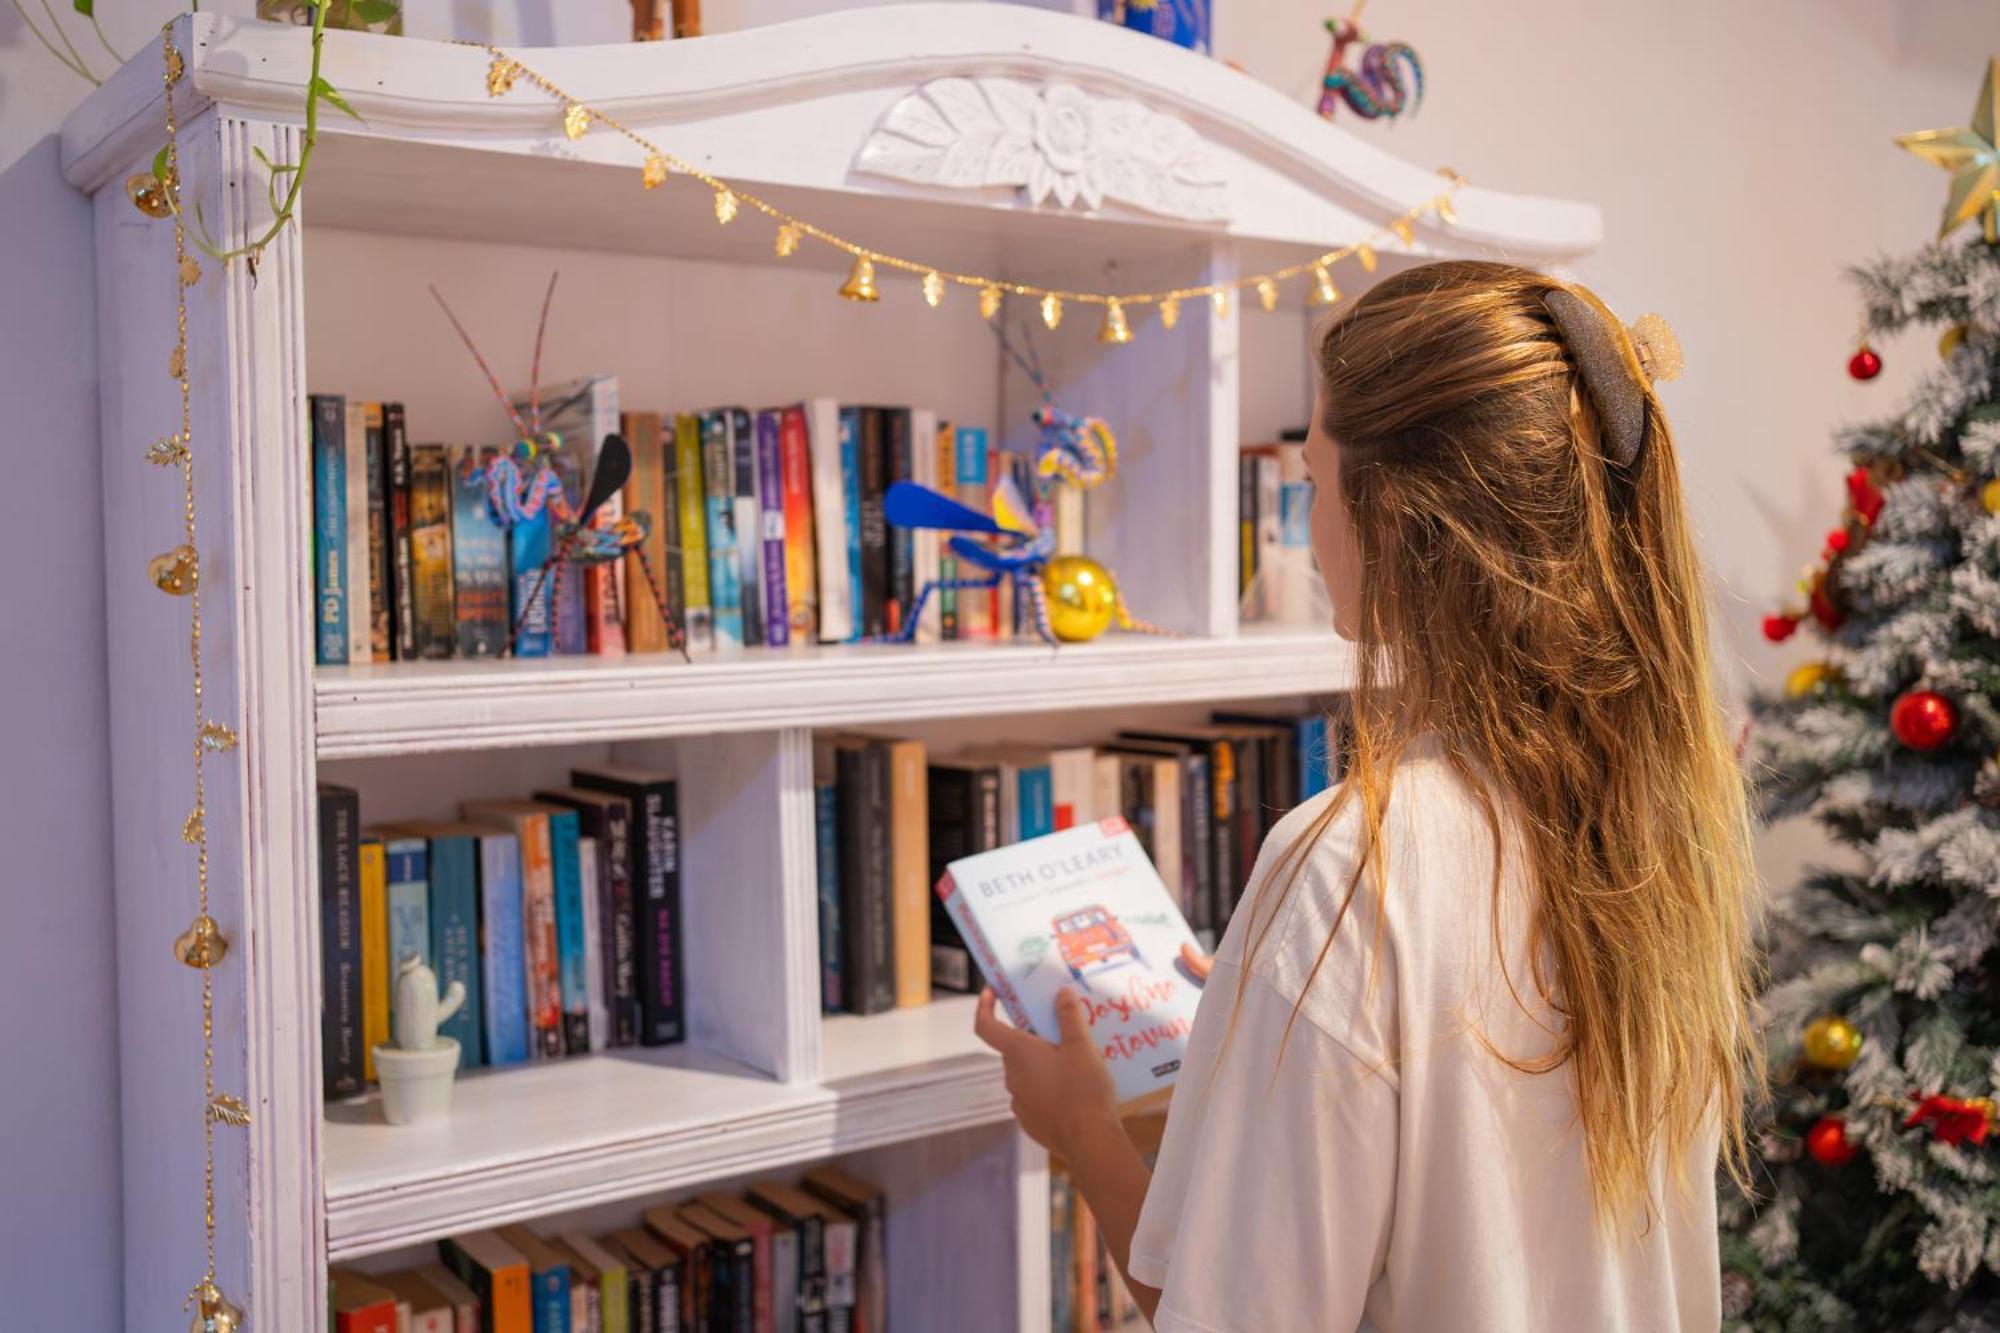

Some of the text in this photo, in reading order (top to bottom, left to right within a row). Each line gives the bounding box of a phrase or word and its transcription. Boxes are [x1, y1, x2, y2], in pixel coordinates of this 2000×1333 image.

[648, 794, 665, 899] SLAUGHTER
[979, 870, 1034, 898] BETH
[1038, 843, 1124, 880] O'LEARY
